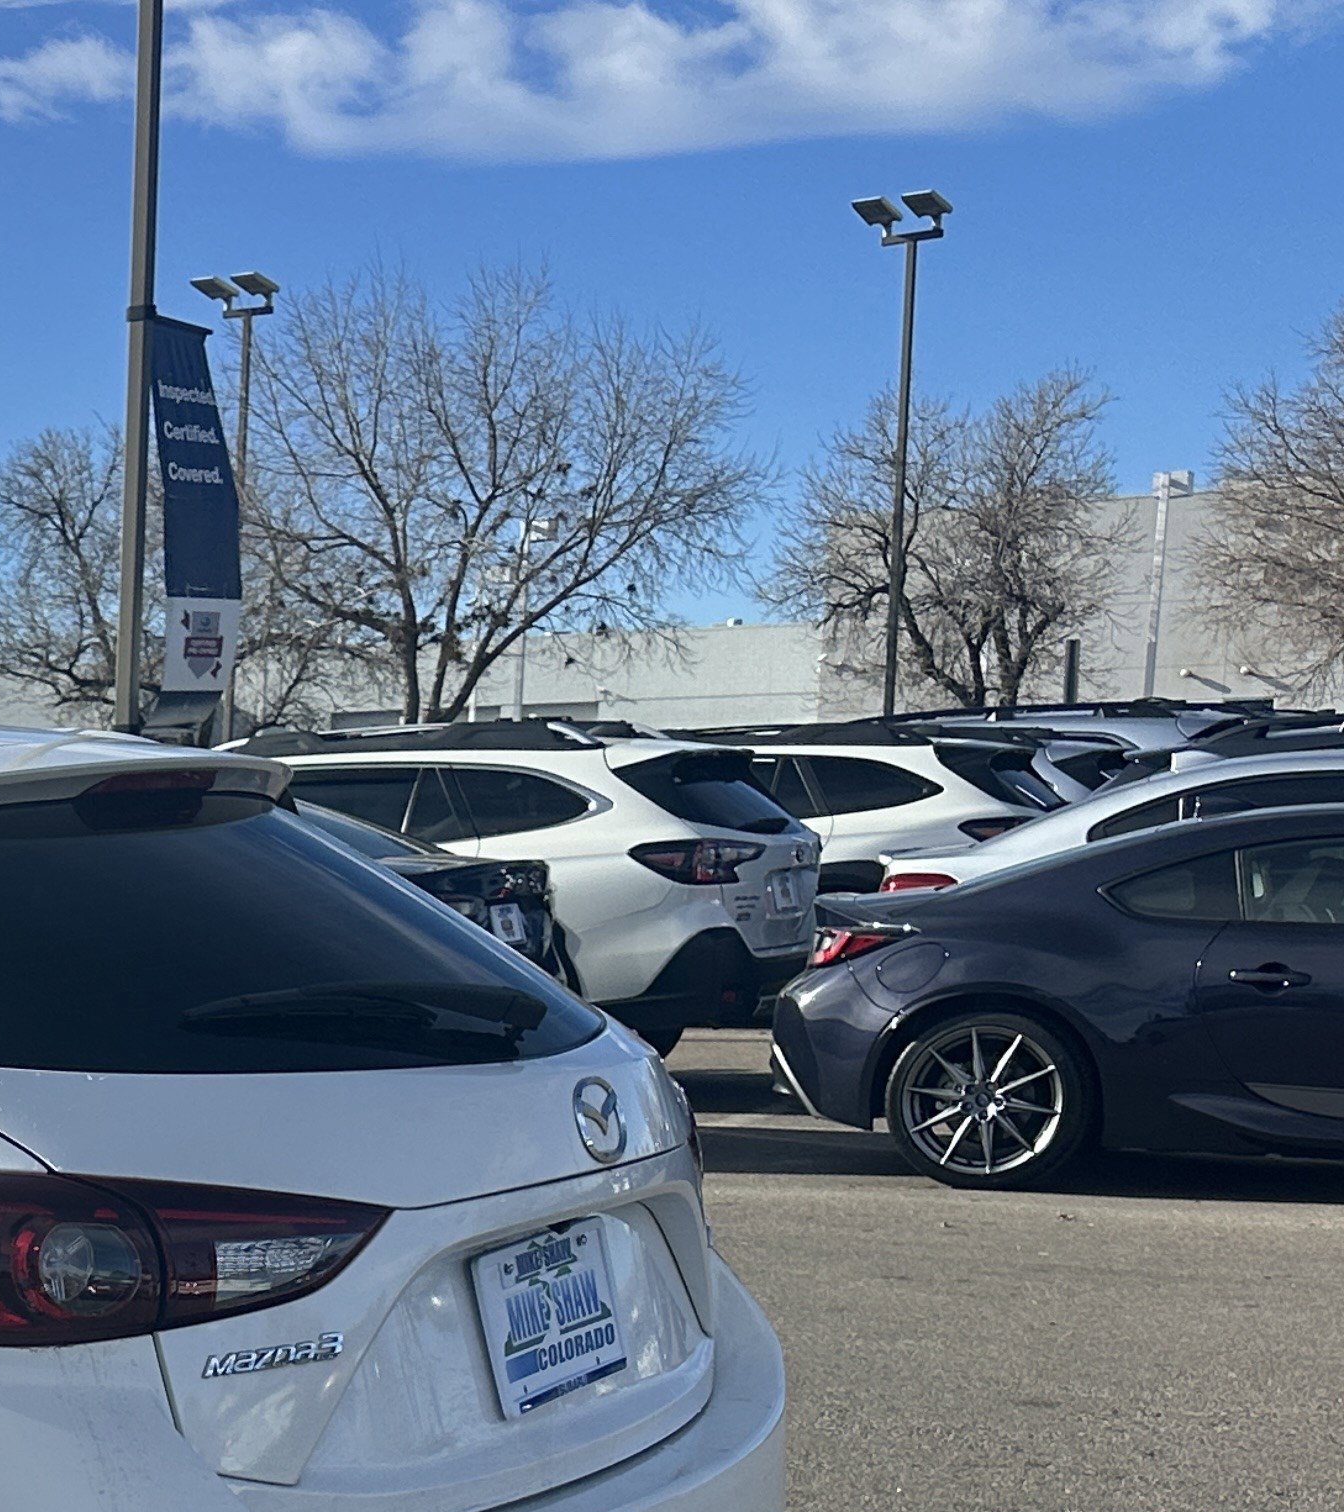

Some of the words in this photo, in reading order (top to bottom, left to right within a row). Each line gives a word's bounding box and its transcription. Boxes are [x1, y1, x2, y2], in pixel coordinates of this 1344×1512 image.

[164, 420, 221, 445] Certified.
[168, 462, 224, 485] Covered.
[506, 1288, 551, 1343] MIKE
[552, 1269, 601, 1326] SHAW
[538, 1323, 616, 1371] COLORADO
